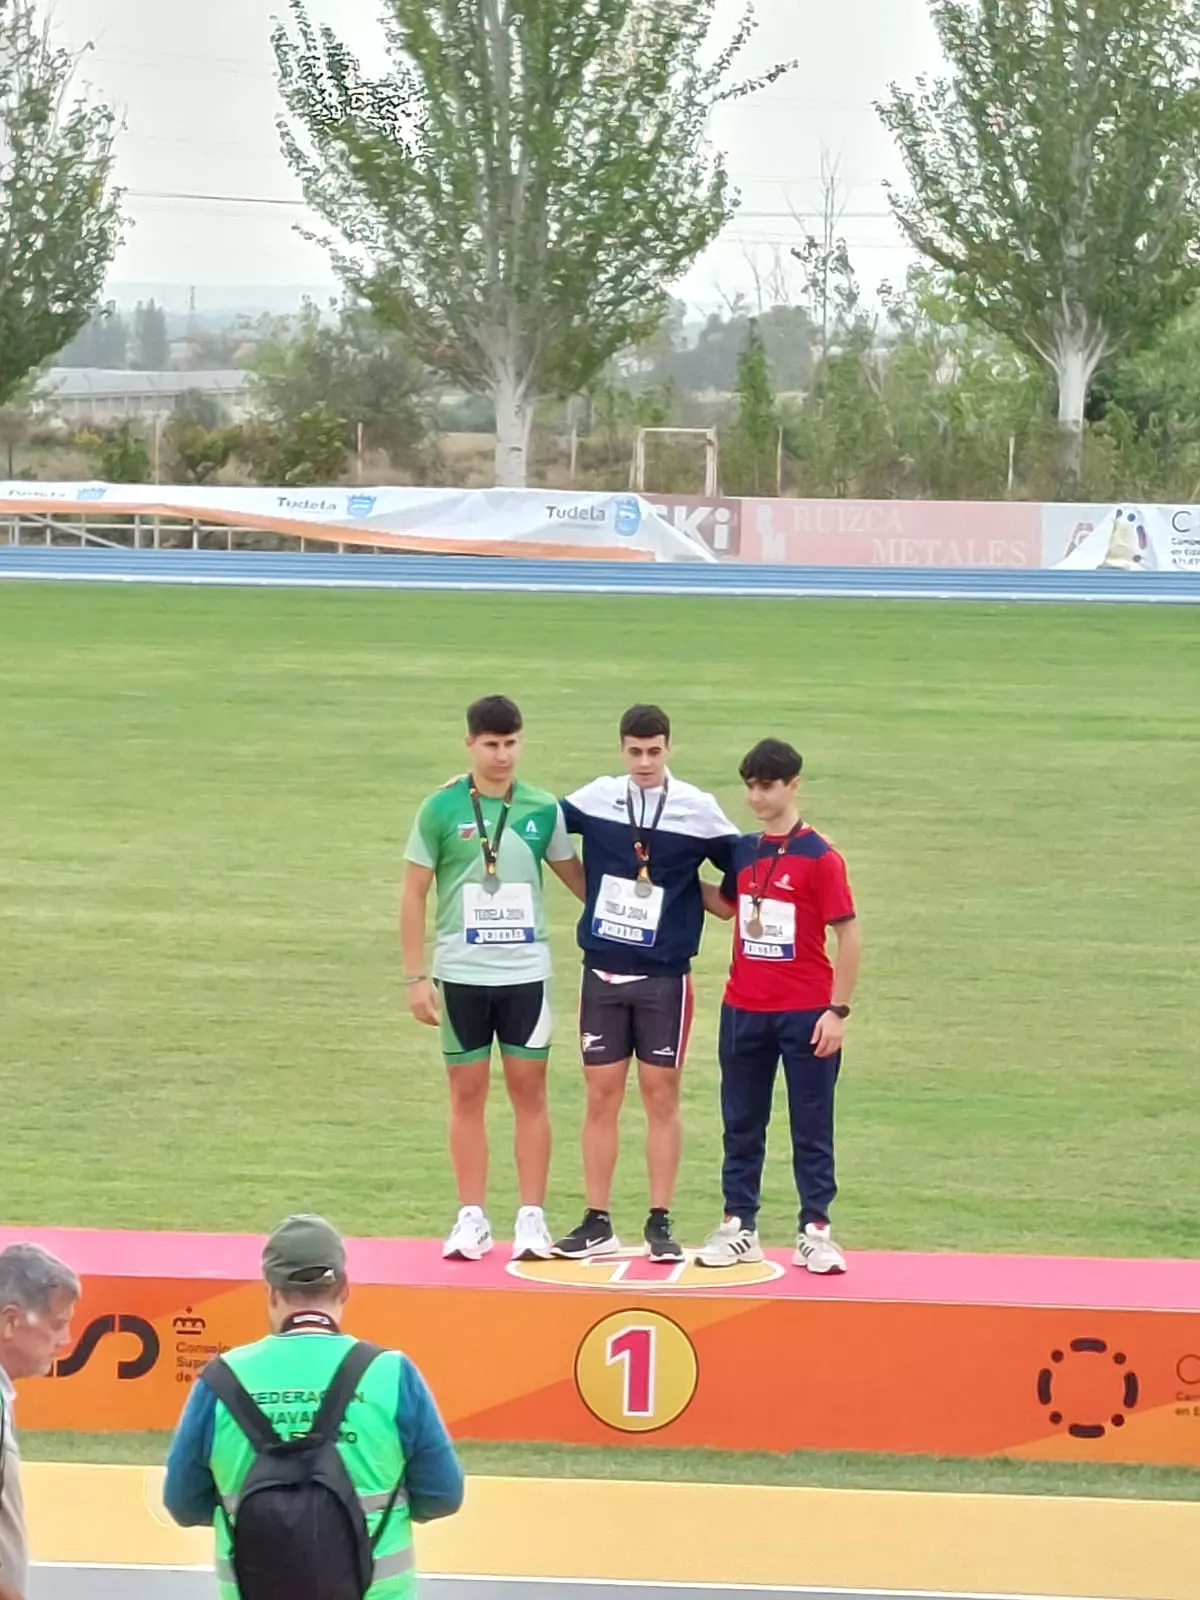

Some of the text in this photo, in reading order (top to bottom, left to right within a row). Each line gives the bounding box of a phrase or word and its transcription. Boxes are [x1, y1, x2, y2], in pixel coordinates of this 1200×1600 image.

[546, 505, 606, 521] Tudela
[792, 505, 904, 533] RUIZCA
[870, 538, 1027, 566] METALES
[605, 1325, 657, 1417] 1
